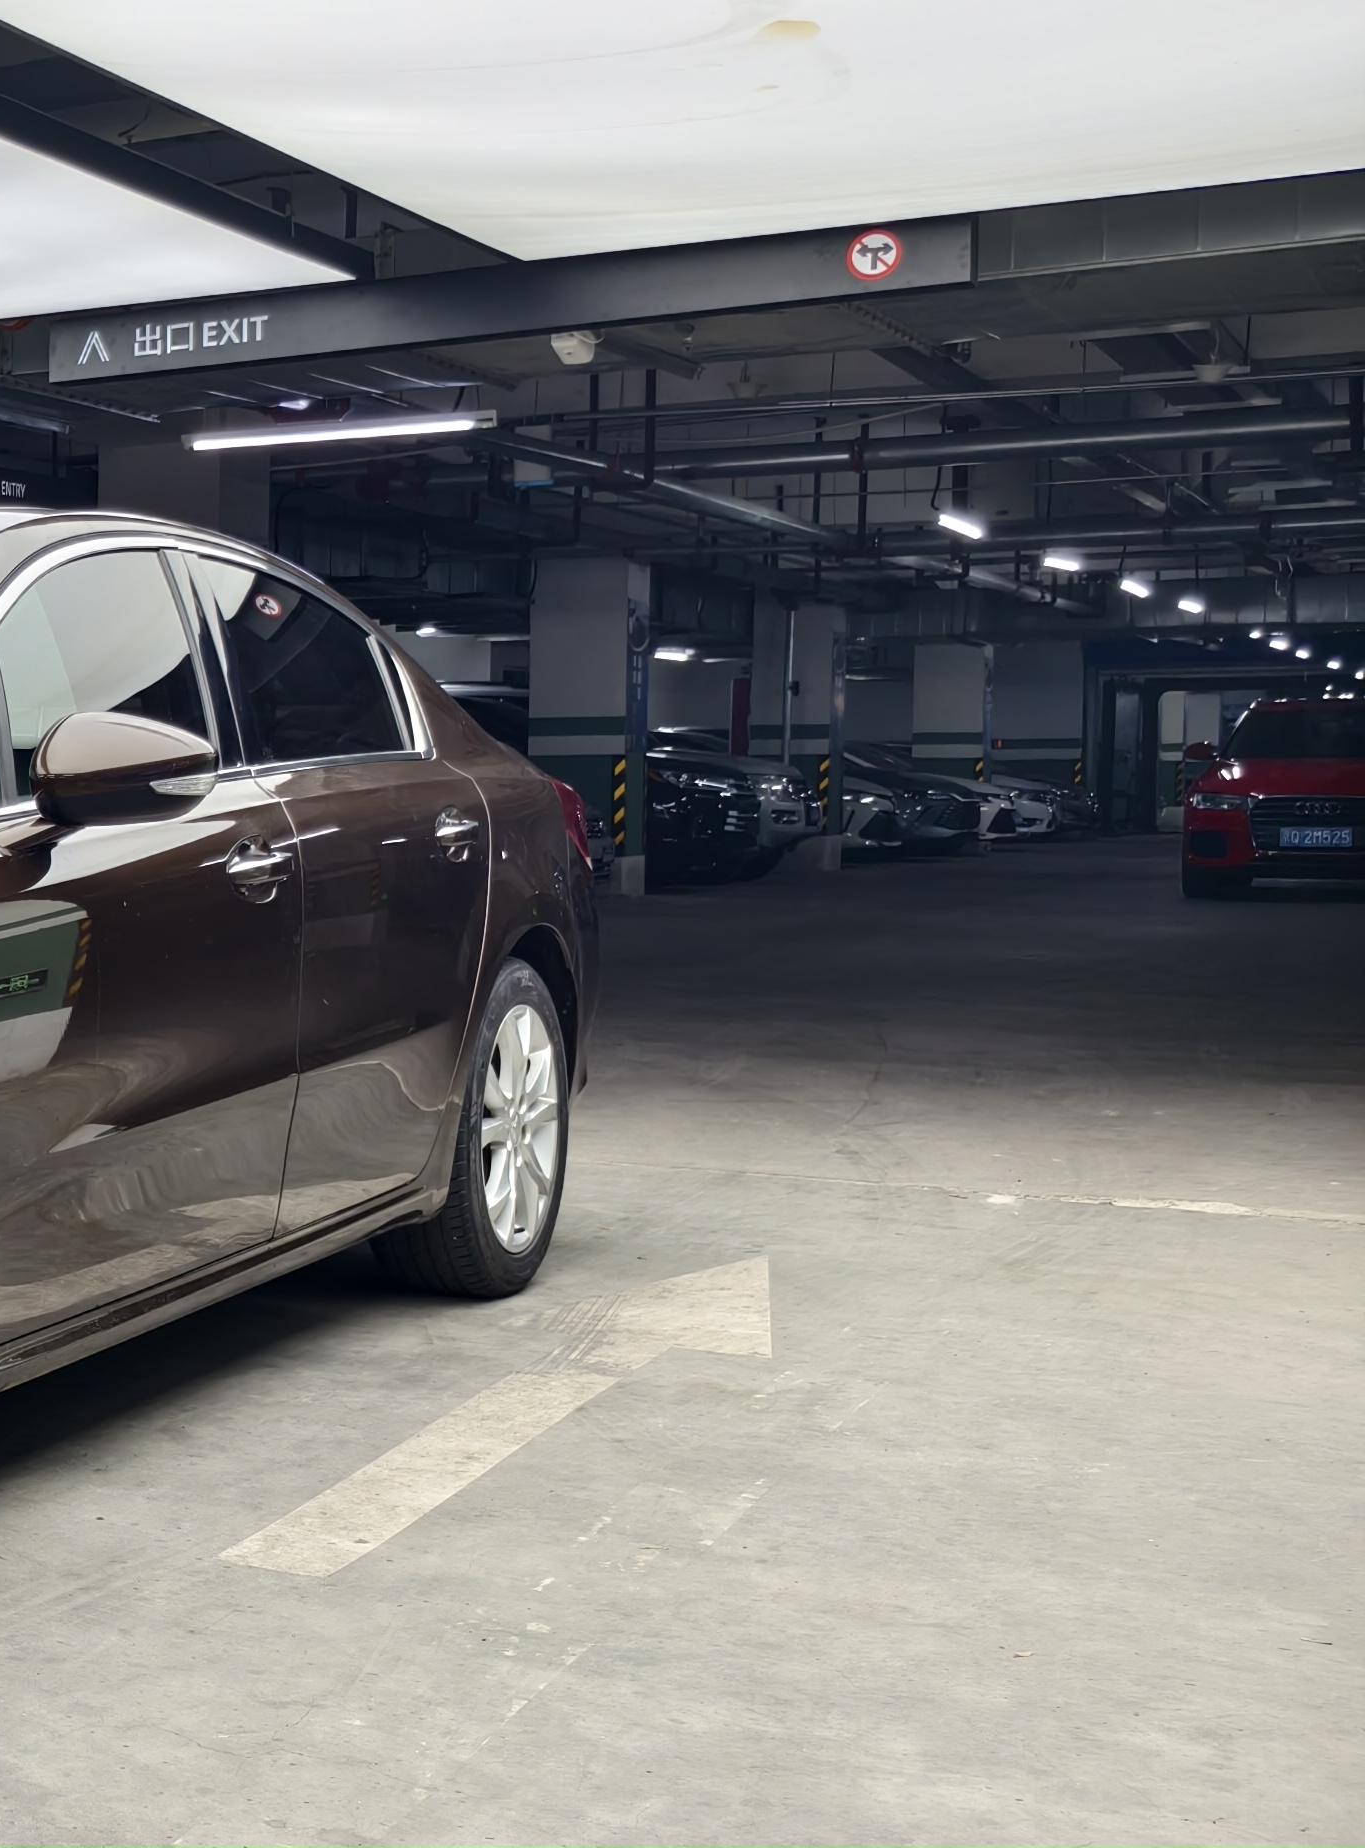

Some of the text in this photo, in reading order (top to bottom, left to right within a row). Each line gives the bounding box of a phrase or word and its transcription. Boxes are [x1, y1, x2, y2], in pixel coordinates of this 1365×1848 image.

[132, 315, 268, 358] 出口 EXIT
[1, 480, 26, 498] ENTRY
